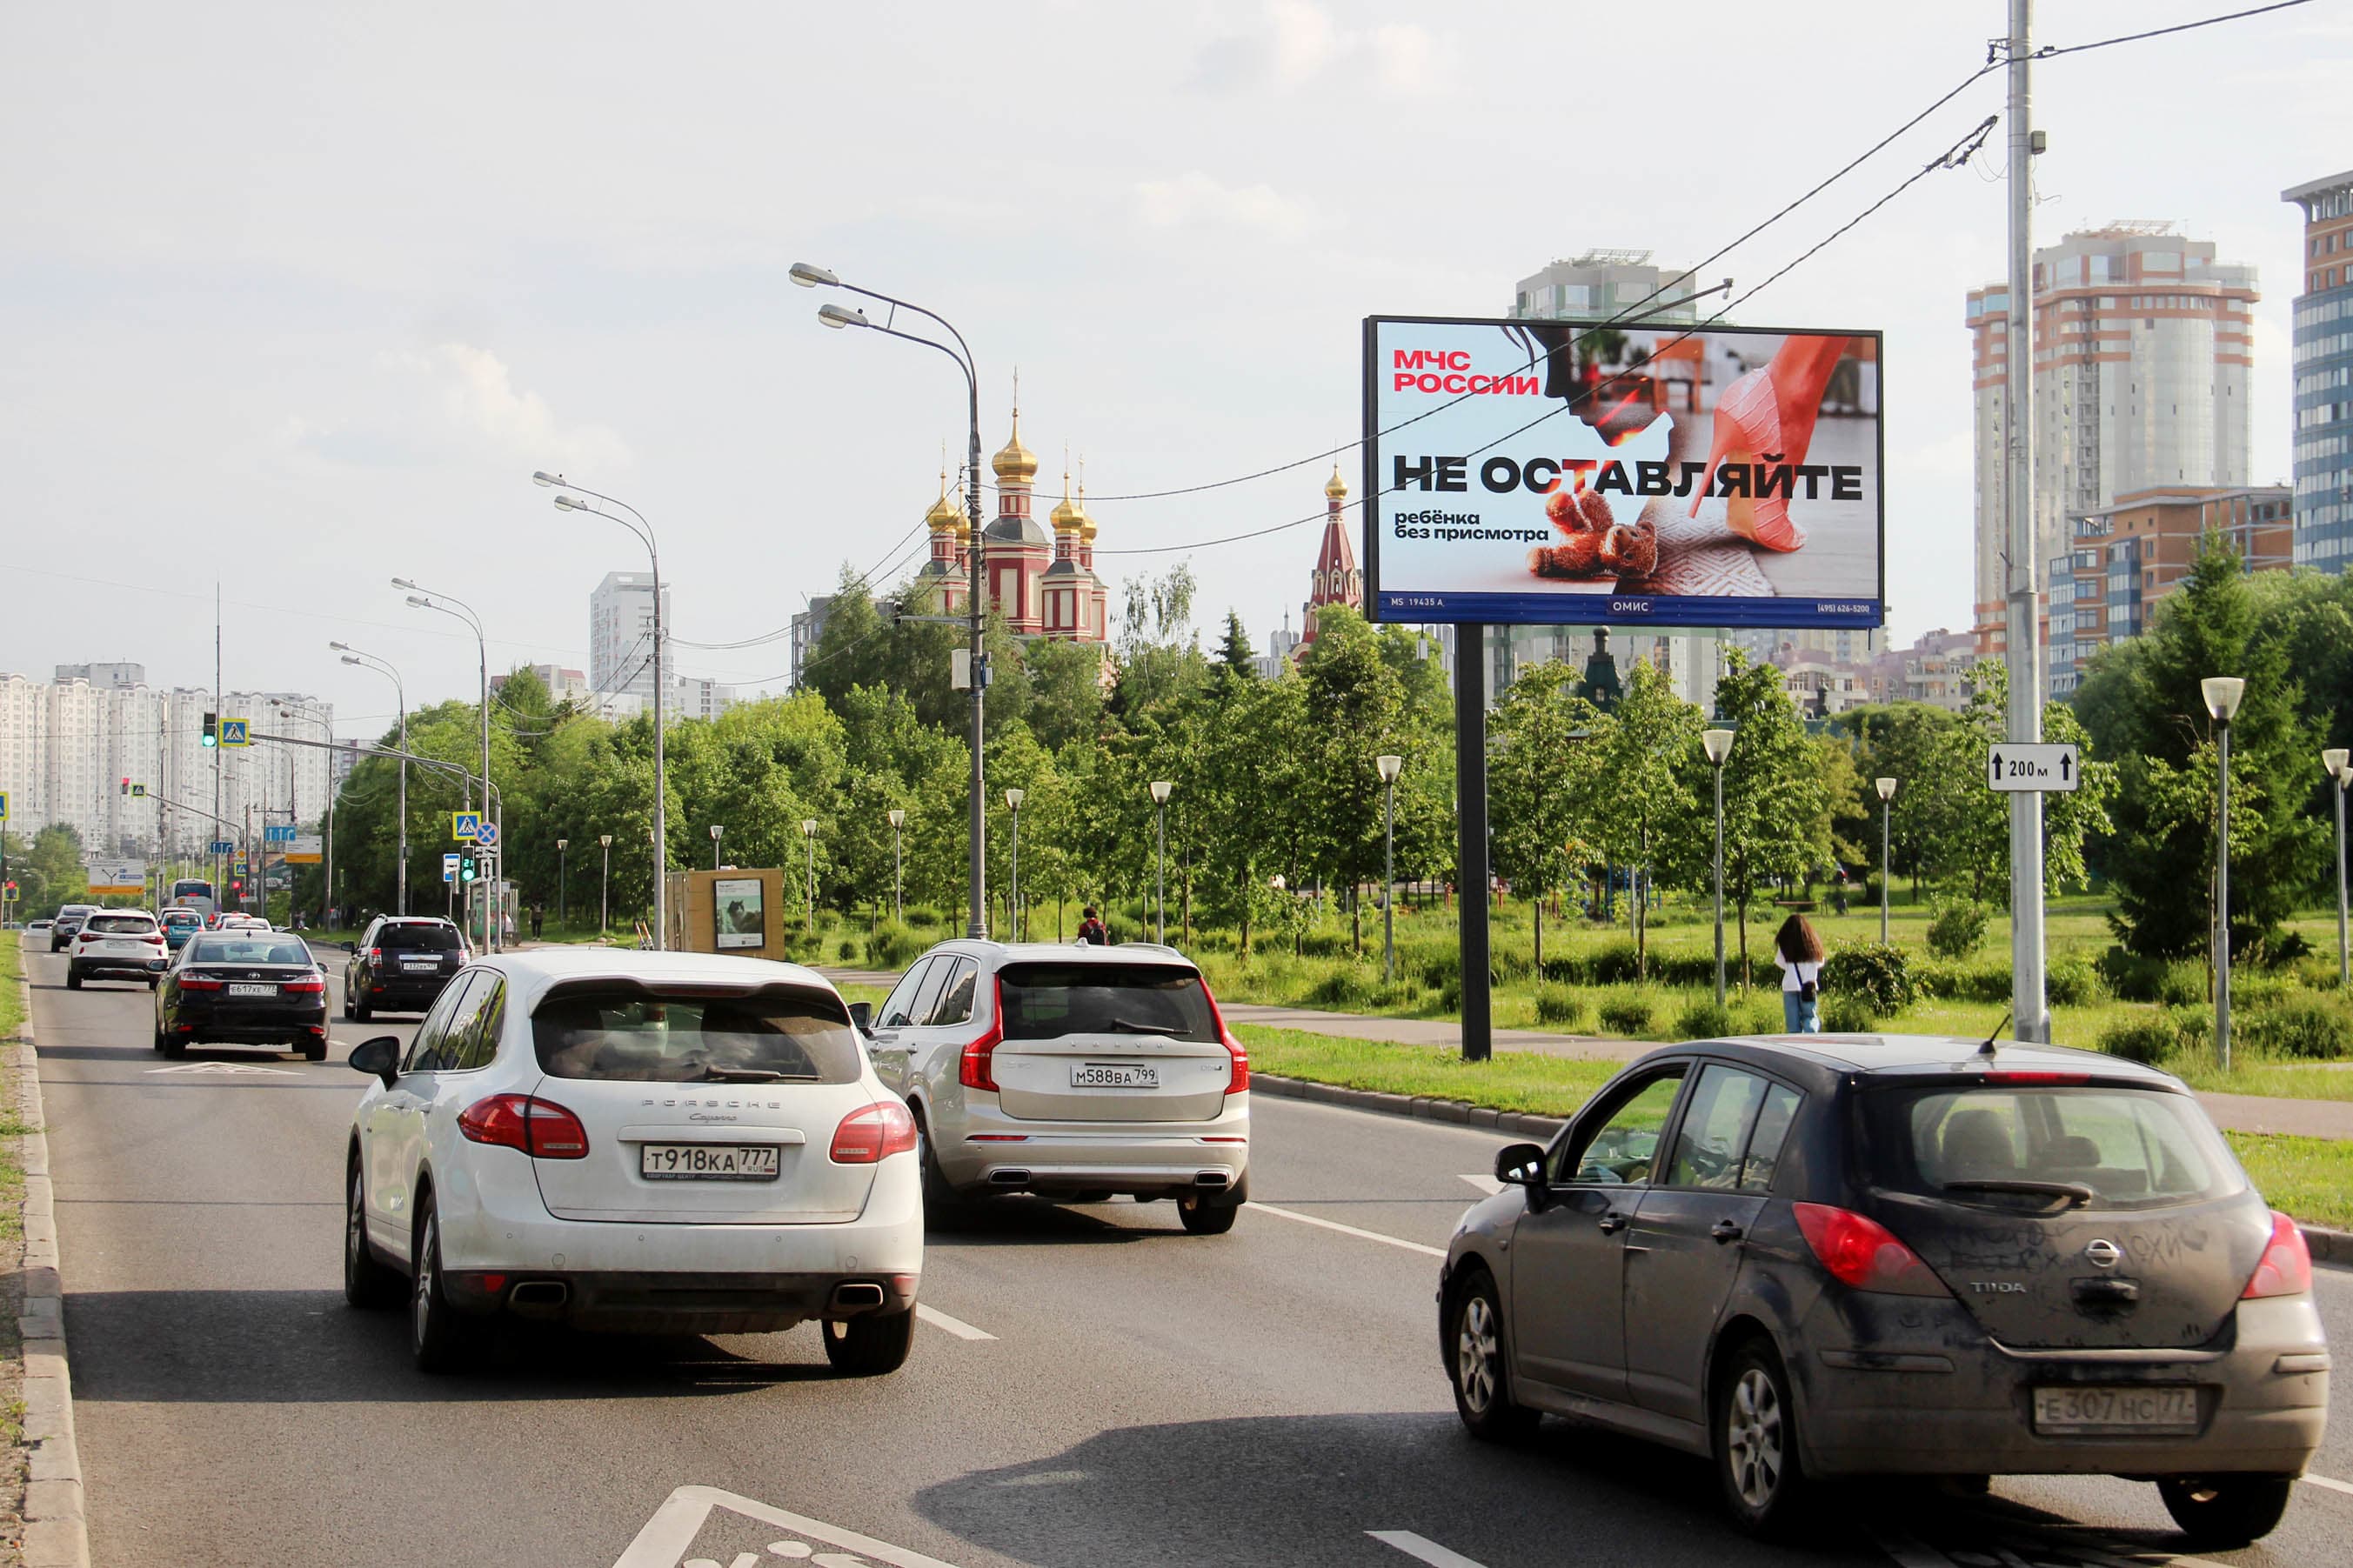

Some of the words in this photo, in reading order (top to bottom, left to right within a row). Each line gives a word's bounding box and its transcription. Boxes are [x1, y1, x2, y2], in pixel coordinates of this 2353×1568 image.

[1394, 350, 1471, 371] МЧС
[1394, 373, 1539, 396] РОССИИ
[1394, 455, 1467, 492] НЕ
[1481, 453, 1862, 501] ОСТАВЛЯЙТЕ
[1394, 510, 1481, 526] ребёнка
[1394, 524, 1430, 539] без
[1434, 529, 1549, 543] присмотра
[1391, 597, 1404, 606] MS
[1613, 601, 1648, 611] ОМИС
[2009, 760, 2035, 777] 200
[642, 1099, 781, 1109] PORSCHE
[1969, 1281, 2027, 1294] TIIDA
